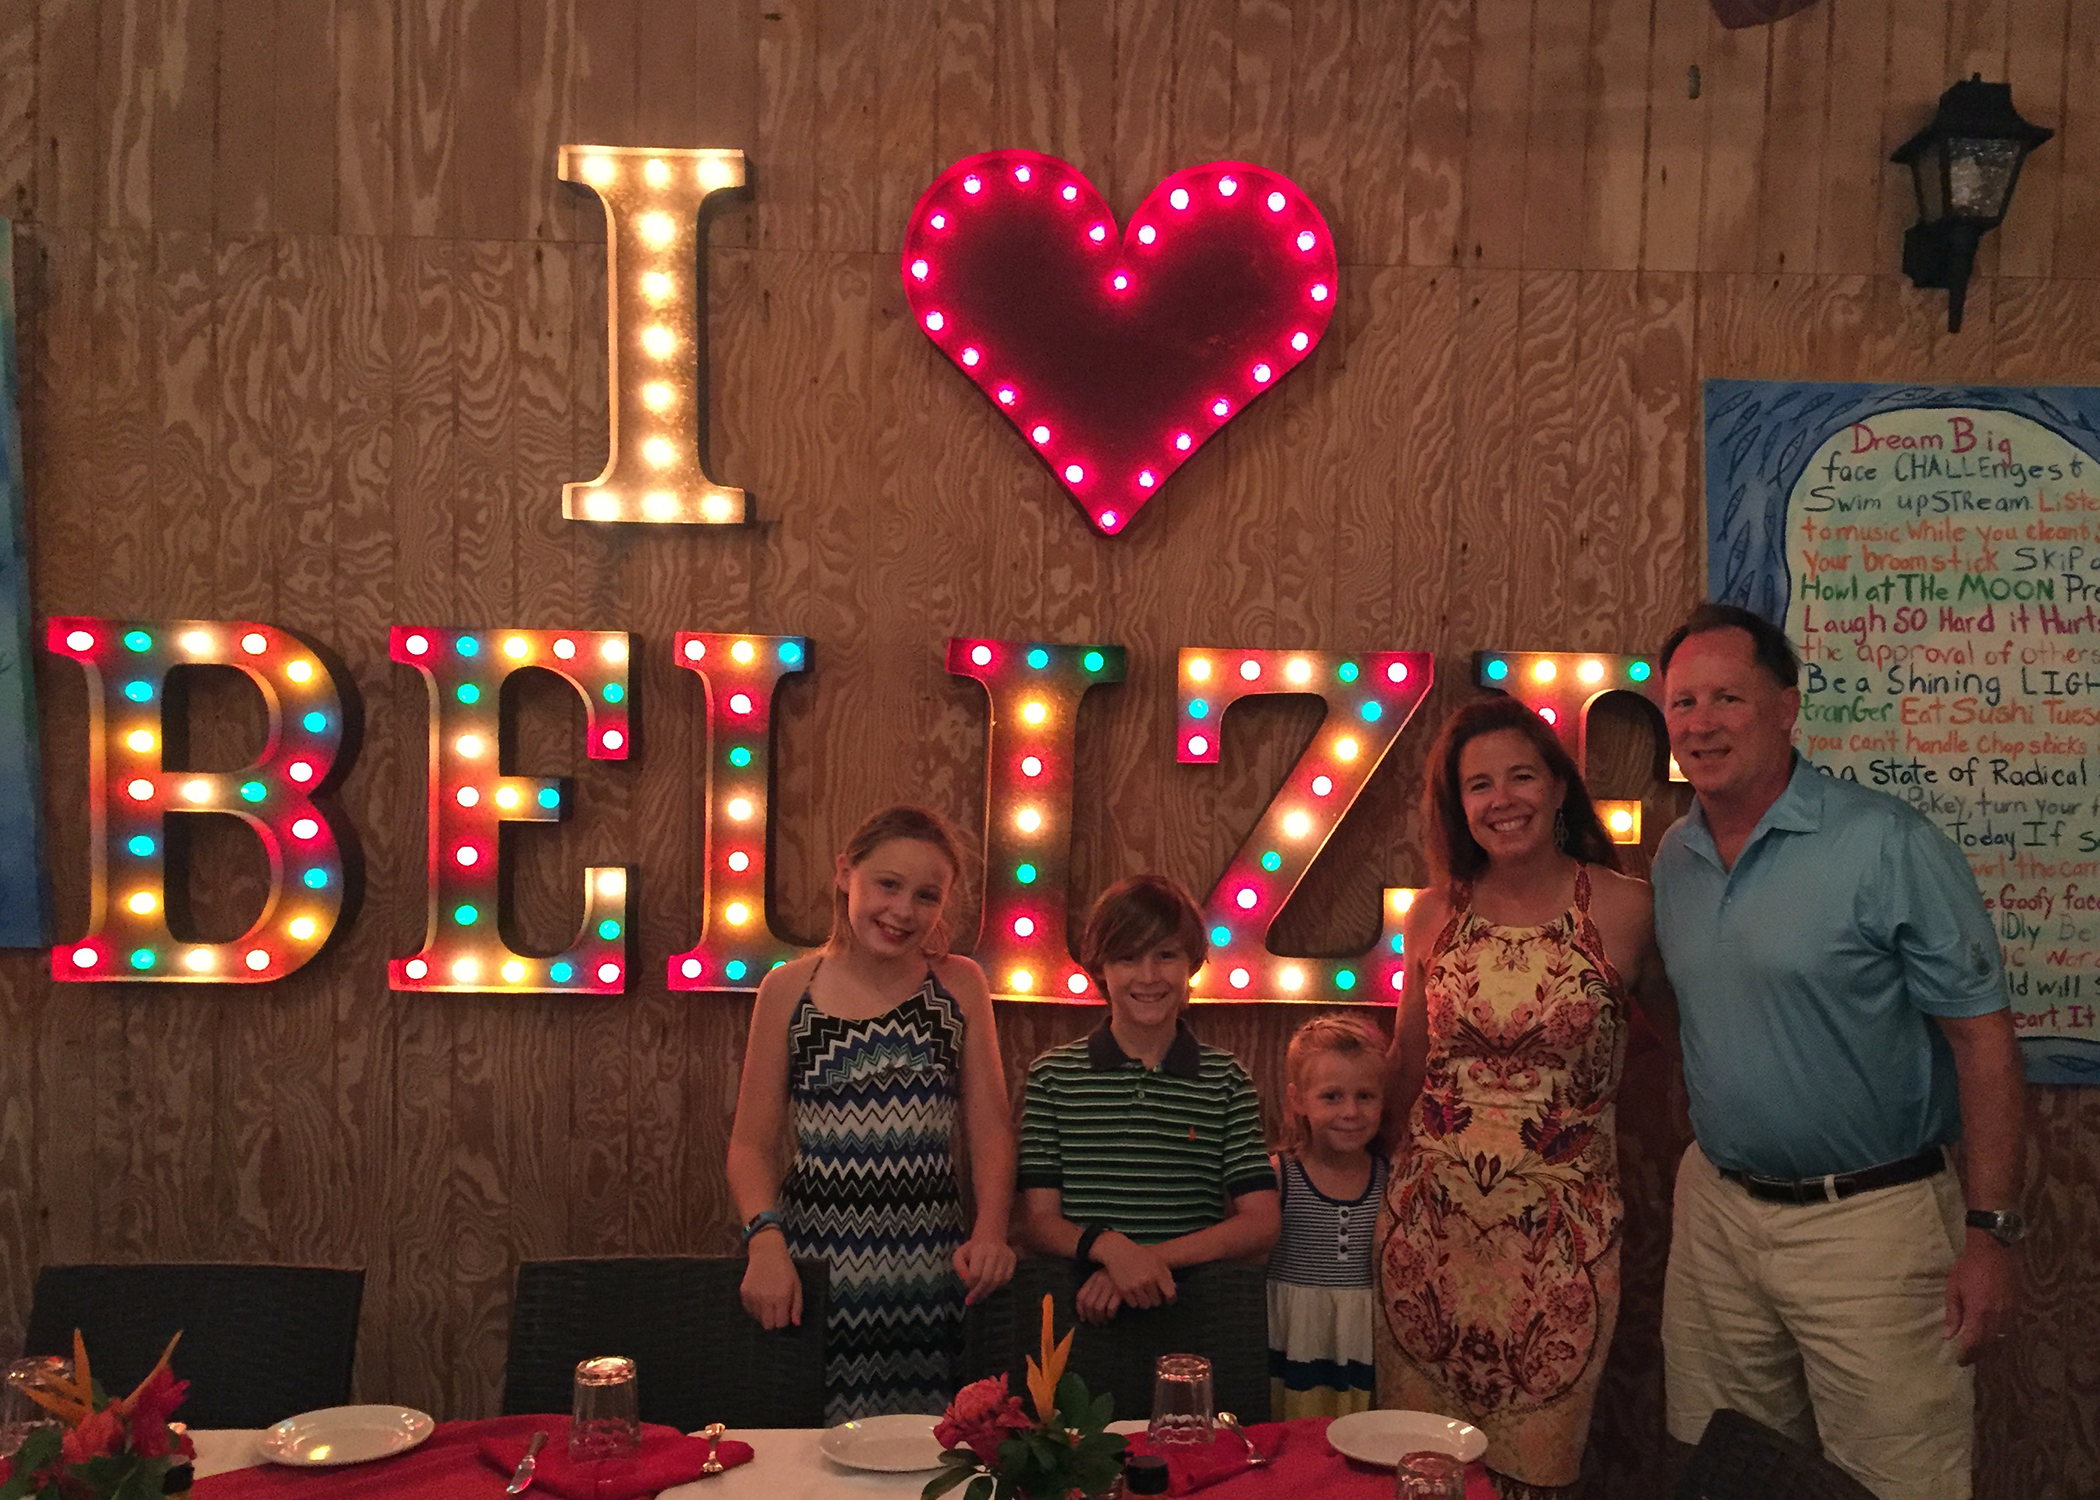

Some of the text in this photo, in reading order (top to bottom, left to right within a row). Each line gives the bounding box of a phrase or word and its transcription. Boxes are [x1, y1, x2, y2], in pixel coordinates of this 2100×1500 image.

[557, 143, 746, 524] I
[1850, 416, 2012, 469] Dream Big
[1822, 451, 1877, 482] face
[1804, 485, 1881, 513] Swim
[1906, 516, 1967, 542] while
[1976, 524, 2018, 550] you
[1864, 574, 1896, 604] at
[1958, 572, 2054, 602] MOON
[1804, 604, 1886, 645] Laugh
[1939, 604, 1996, 634] Hard
[2010, 603, 2030, 634] it
[2039, 604, 2100, 635] Hurt
[1800, 633, 1843, 662] the
[1856, 640, 1973, 672] approval
[1985, 640, 2013, 665] of
[1802, 662, 1847, 694] Be
[1855, 679, 1871, 694] a
[1887, 662, 2001, 706] Shining
[1900, 698, 1945, 725] Eat
[1950, 696, 2034, 725] Sushi
[1808, 735, 1842, 757] you
[1905, 726, 1969, 753] handle
[1870, 755, 1938, 786] State
[1949, 756, 1979, 786] of
[1990, 757, 2088, 787] Radical
[1975, 787, 2027, 817] turn
[1945, 818, 2016, 861] Today
[2021, 820, 2065, 847] If
[1999, 883, 2056, 920] Goofy
[2036, 974, 2080, 998] will
[2067, 1004, 2096, 1028] It
